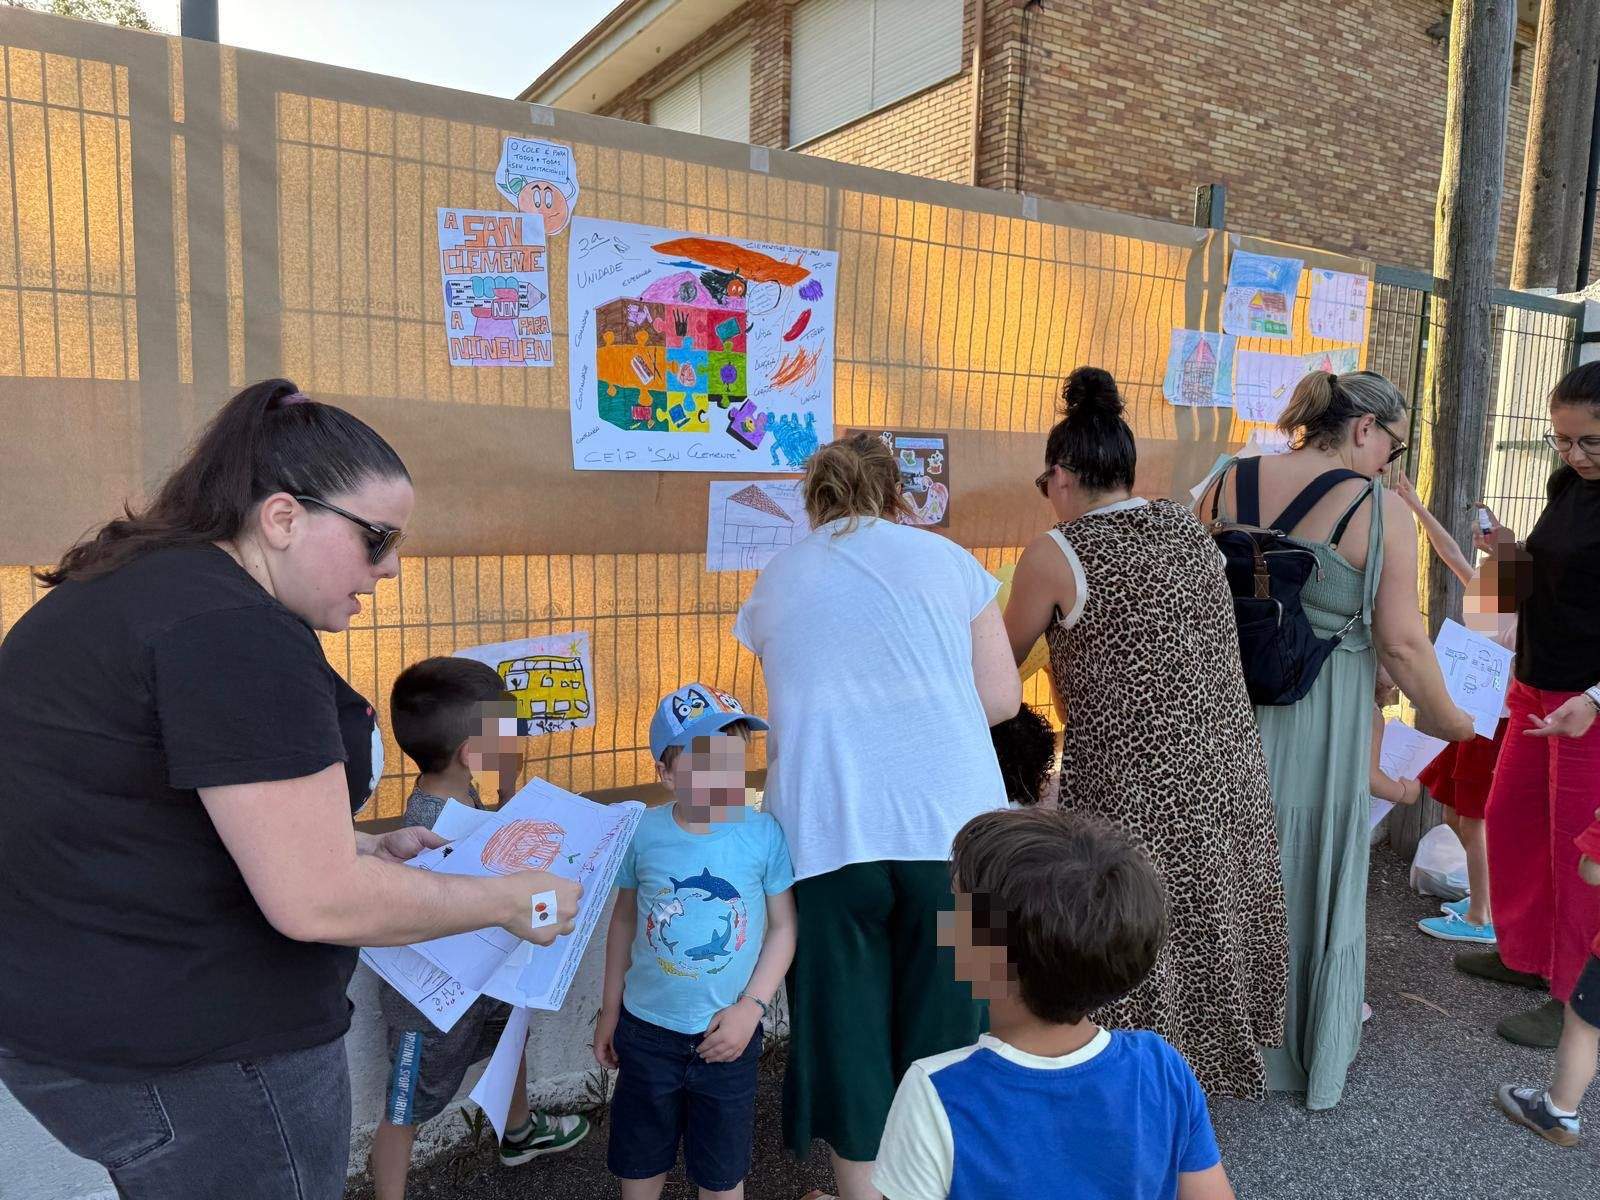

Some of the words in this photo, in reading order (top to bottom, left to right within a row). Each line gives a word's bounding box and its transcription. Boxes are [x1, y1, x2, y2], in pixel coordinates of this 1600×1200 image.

[511, 142, 518, 150] O
[522, 145, 540, 153] COLE
[513, 154, 534, 162] TODOS
[444, 211, 458, 229] A
[463, 215, 523, 248] SAN
[443, 244, 546, 275] CLEMENTE
[492, 301, 519, 318] NON
[450, 310, 464, 330] A
[519, 315, 551, 335] PARA
[450, 335, 553, 362] NINGUEN
